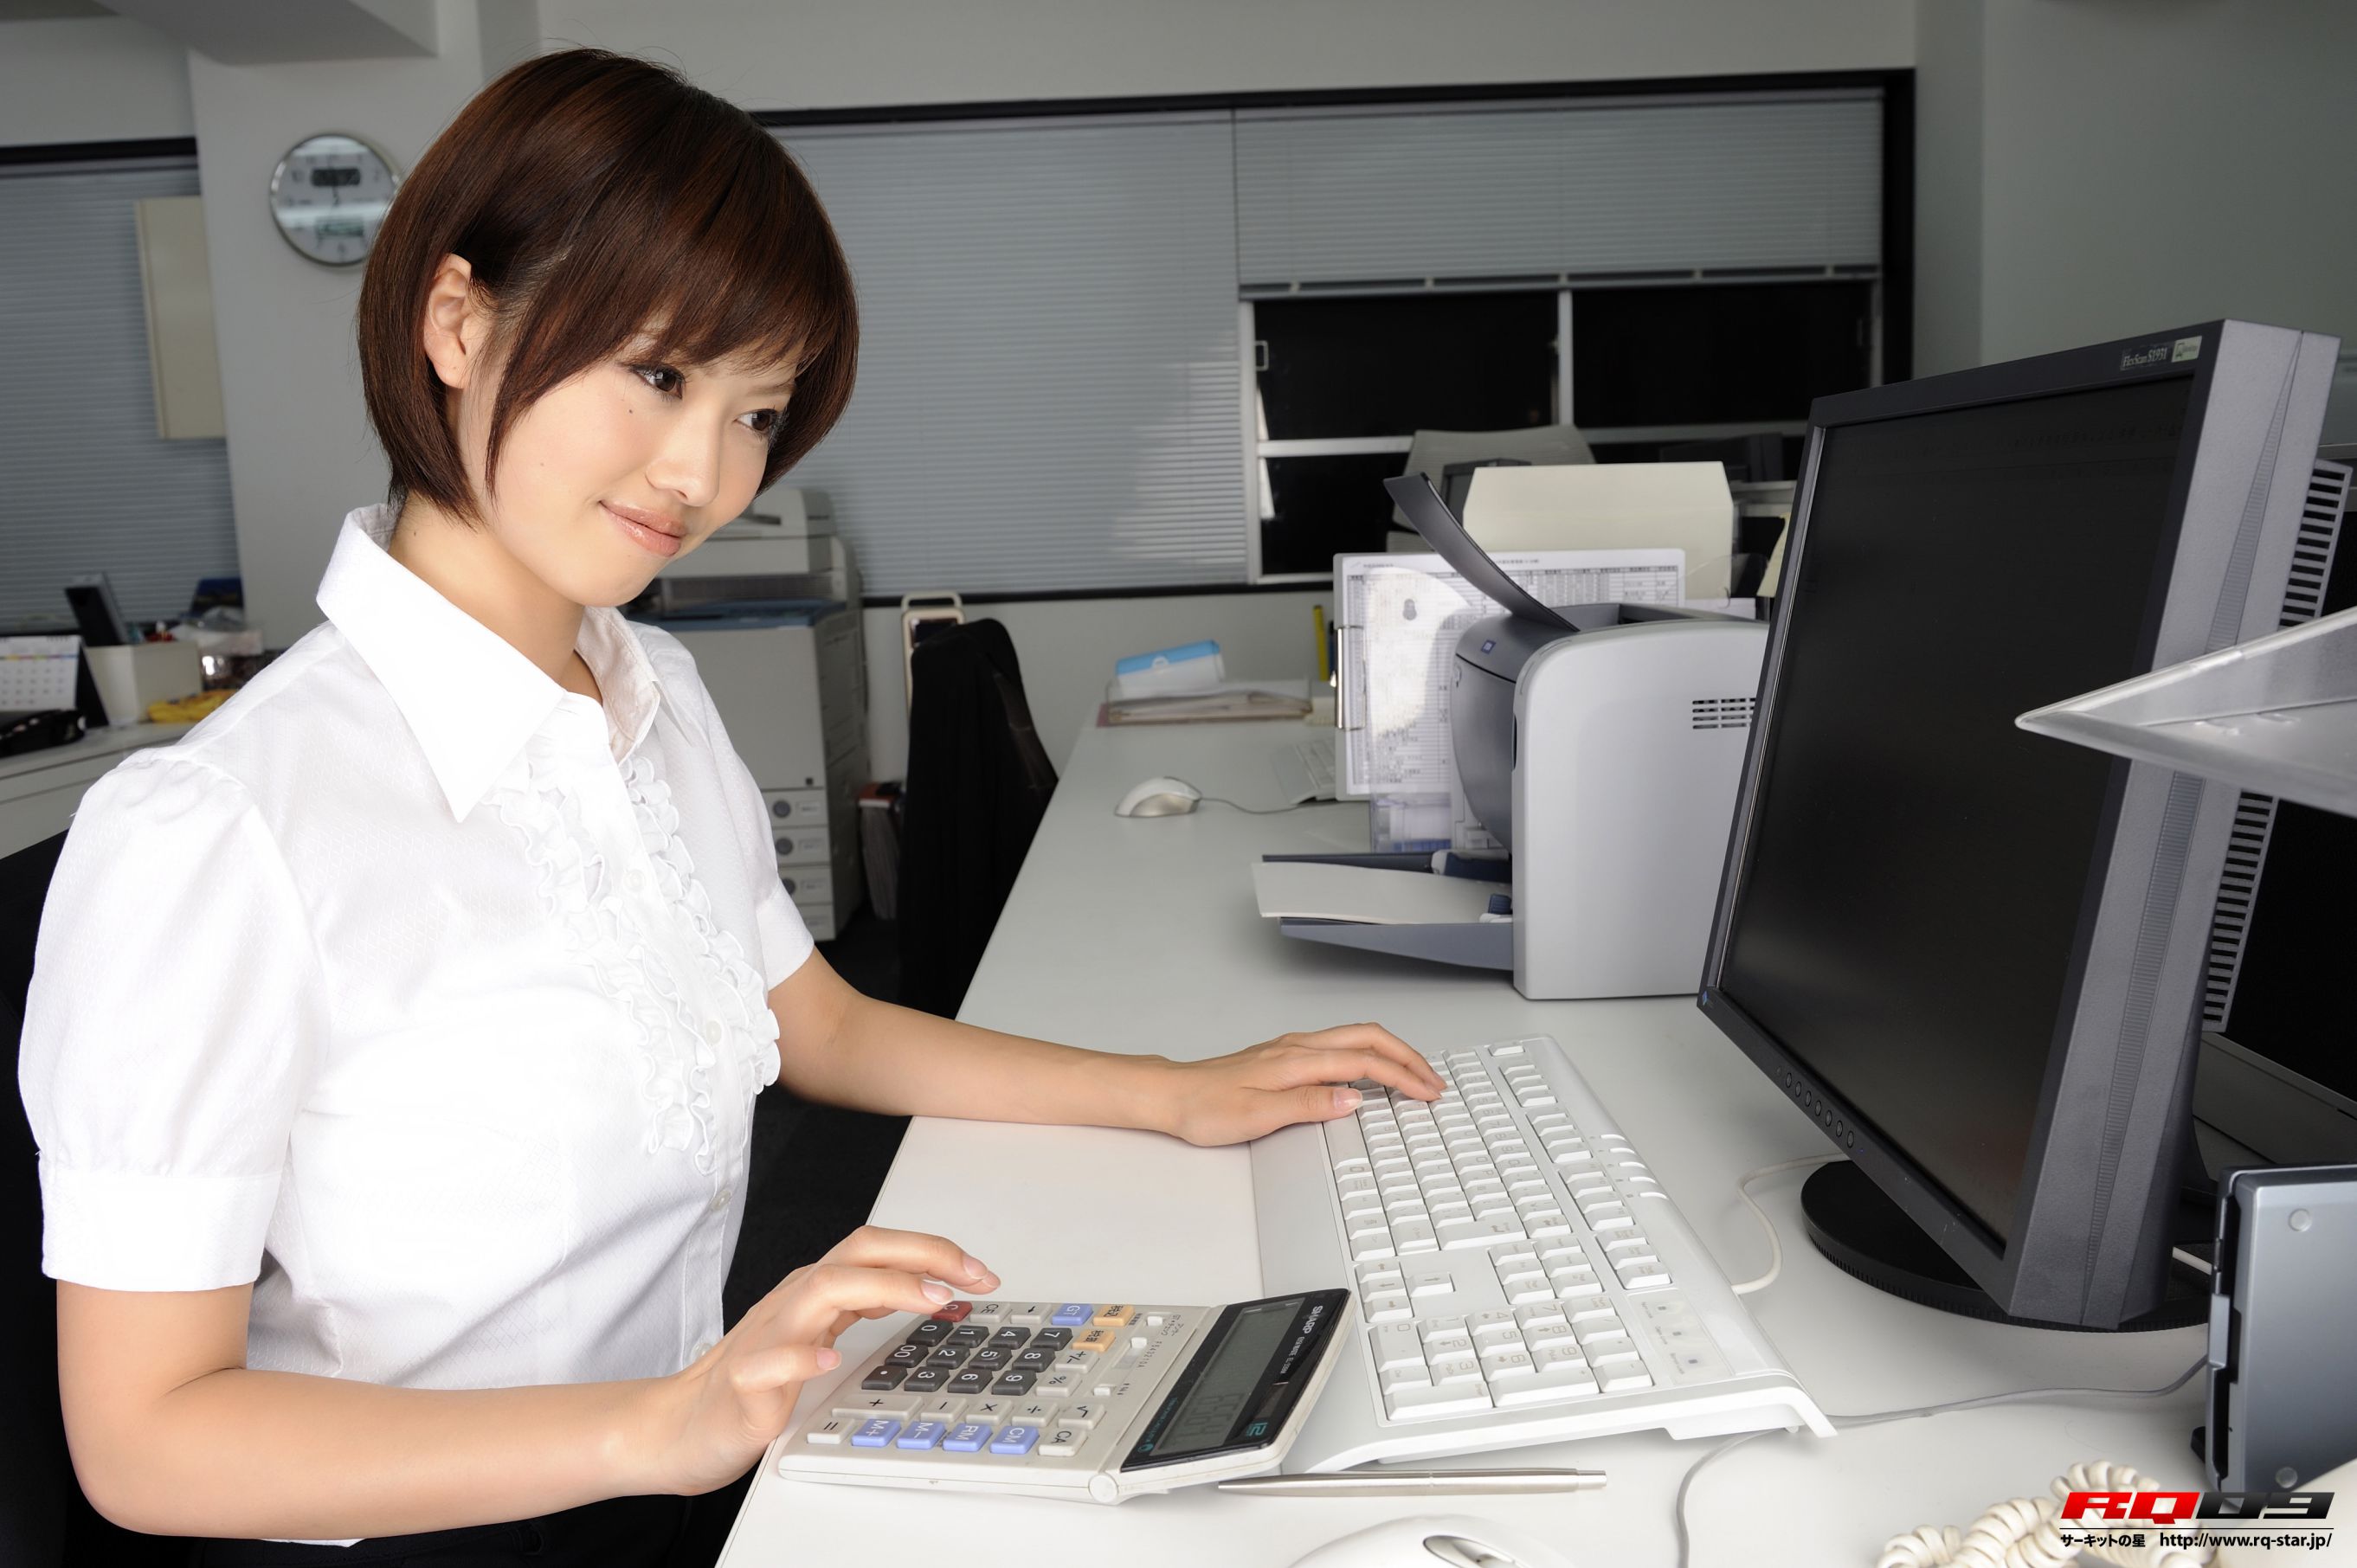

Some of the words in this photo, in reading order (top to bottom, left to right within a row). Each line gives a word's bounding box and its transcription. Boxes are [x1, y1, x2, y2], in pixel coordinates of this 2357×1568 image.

[980, 1303, 1000, 1314] CE
[1063, 1305, 1081, 1315] GT
[1542, 1303, 1558, 1312] 7
[1302, 1305, 1323, 1334] SHARP
[1495, 1311, 1510, 1320] 4
[1551, 1325, 1568, 1334] 8
[1502, 1331, 1518, 1340] 5
[1452, 1339, 1467, 1347] 2
[894, 1345, 917, 1358] 00
[980, 1350, 998, 1359] 5
[1562, 1346, 1577, 1356] 9
[1510, 1354, 1526, 1365] 6
[1459, 1360, 1475, 1371] 3
[918, 1371, 936, 1379] 3
[1048, 1375, 1067, 1385] %
[866, 1419, 890, 1436] M+
[955, 1424, 979, 1441] RM
[1001, 1428, 1025, 1444] CM
[1052, 1430, 1072, 1444] CA
